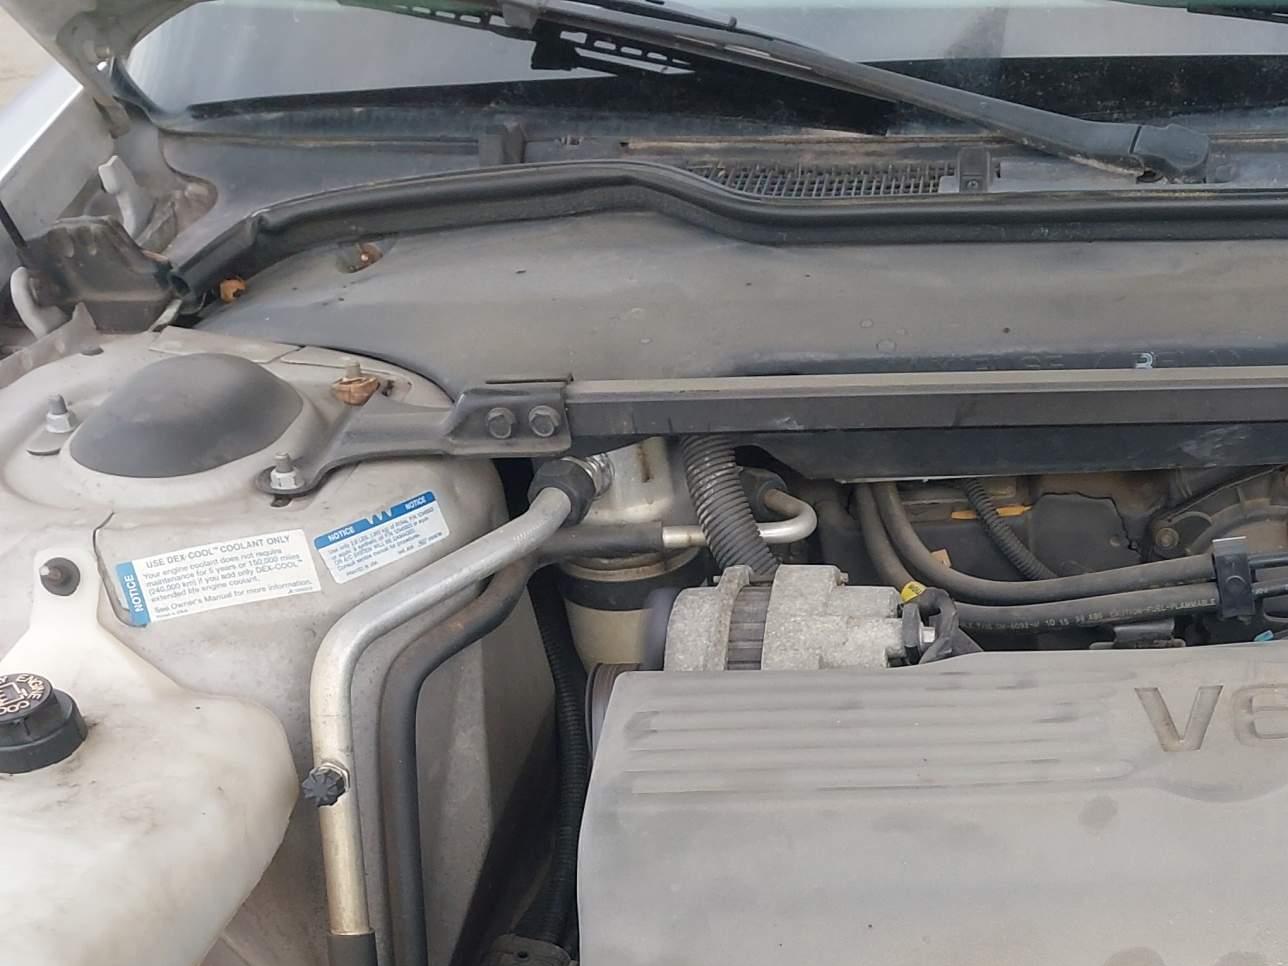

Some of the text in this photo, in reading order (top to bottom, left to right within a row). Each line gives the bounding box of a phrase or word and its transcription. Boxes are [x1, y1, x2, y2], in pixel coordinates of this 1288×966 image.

[405, 496, 426, 510] NOTICE
[328, 527, 355, 542] NOTICE
[146, 536, 290, 568] USE COOLANT ONLY
[146, 573, 194, 587] maintenance
[215, 565, 236, 573] years
[163, 566, 188, 576] engine
[190, 559, 219, 570] coolant
[205, 569, 254, 584] you only
[124, 574, 144, 612] NOTICE
[152, 582, 227, 602] extended engine
[204, 593, 232, 602] Manual
[16, 674, 44, 700] ENGINE
